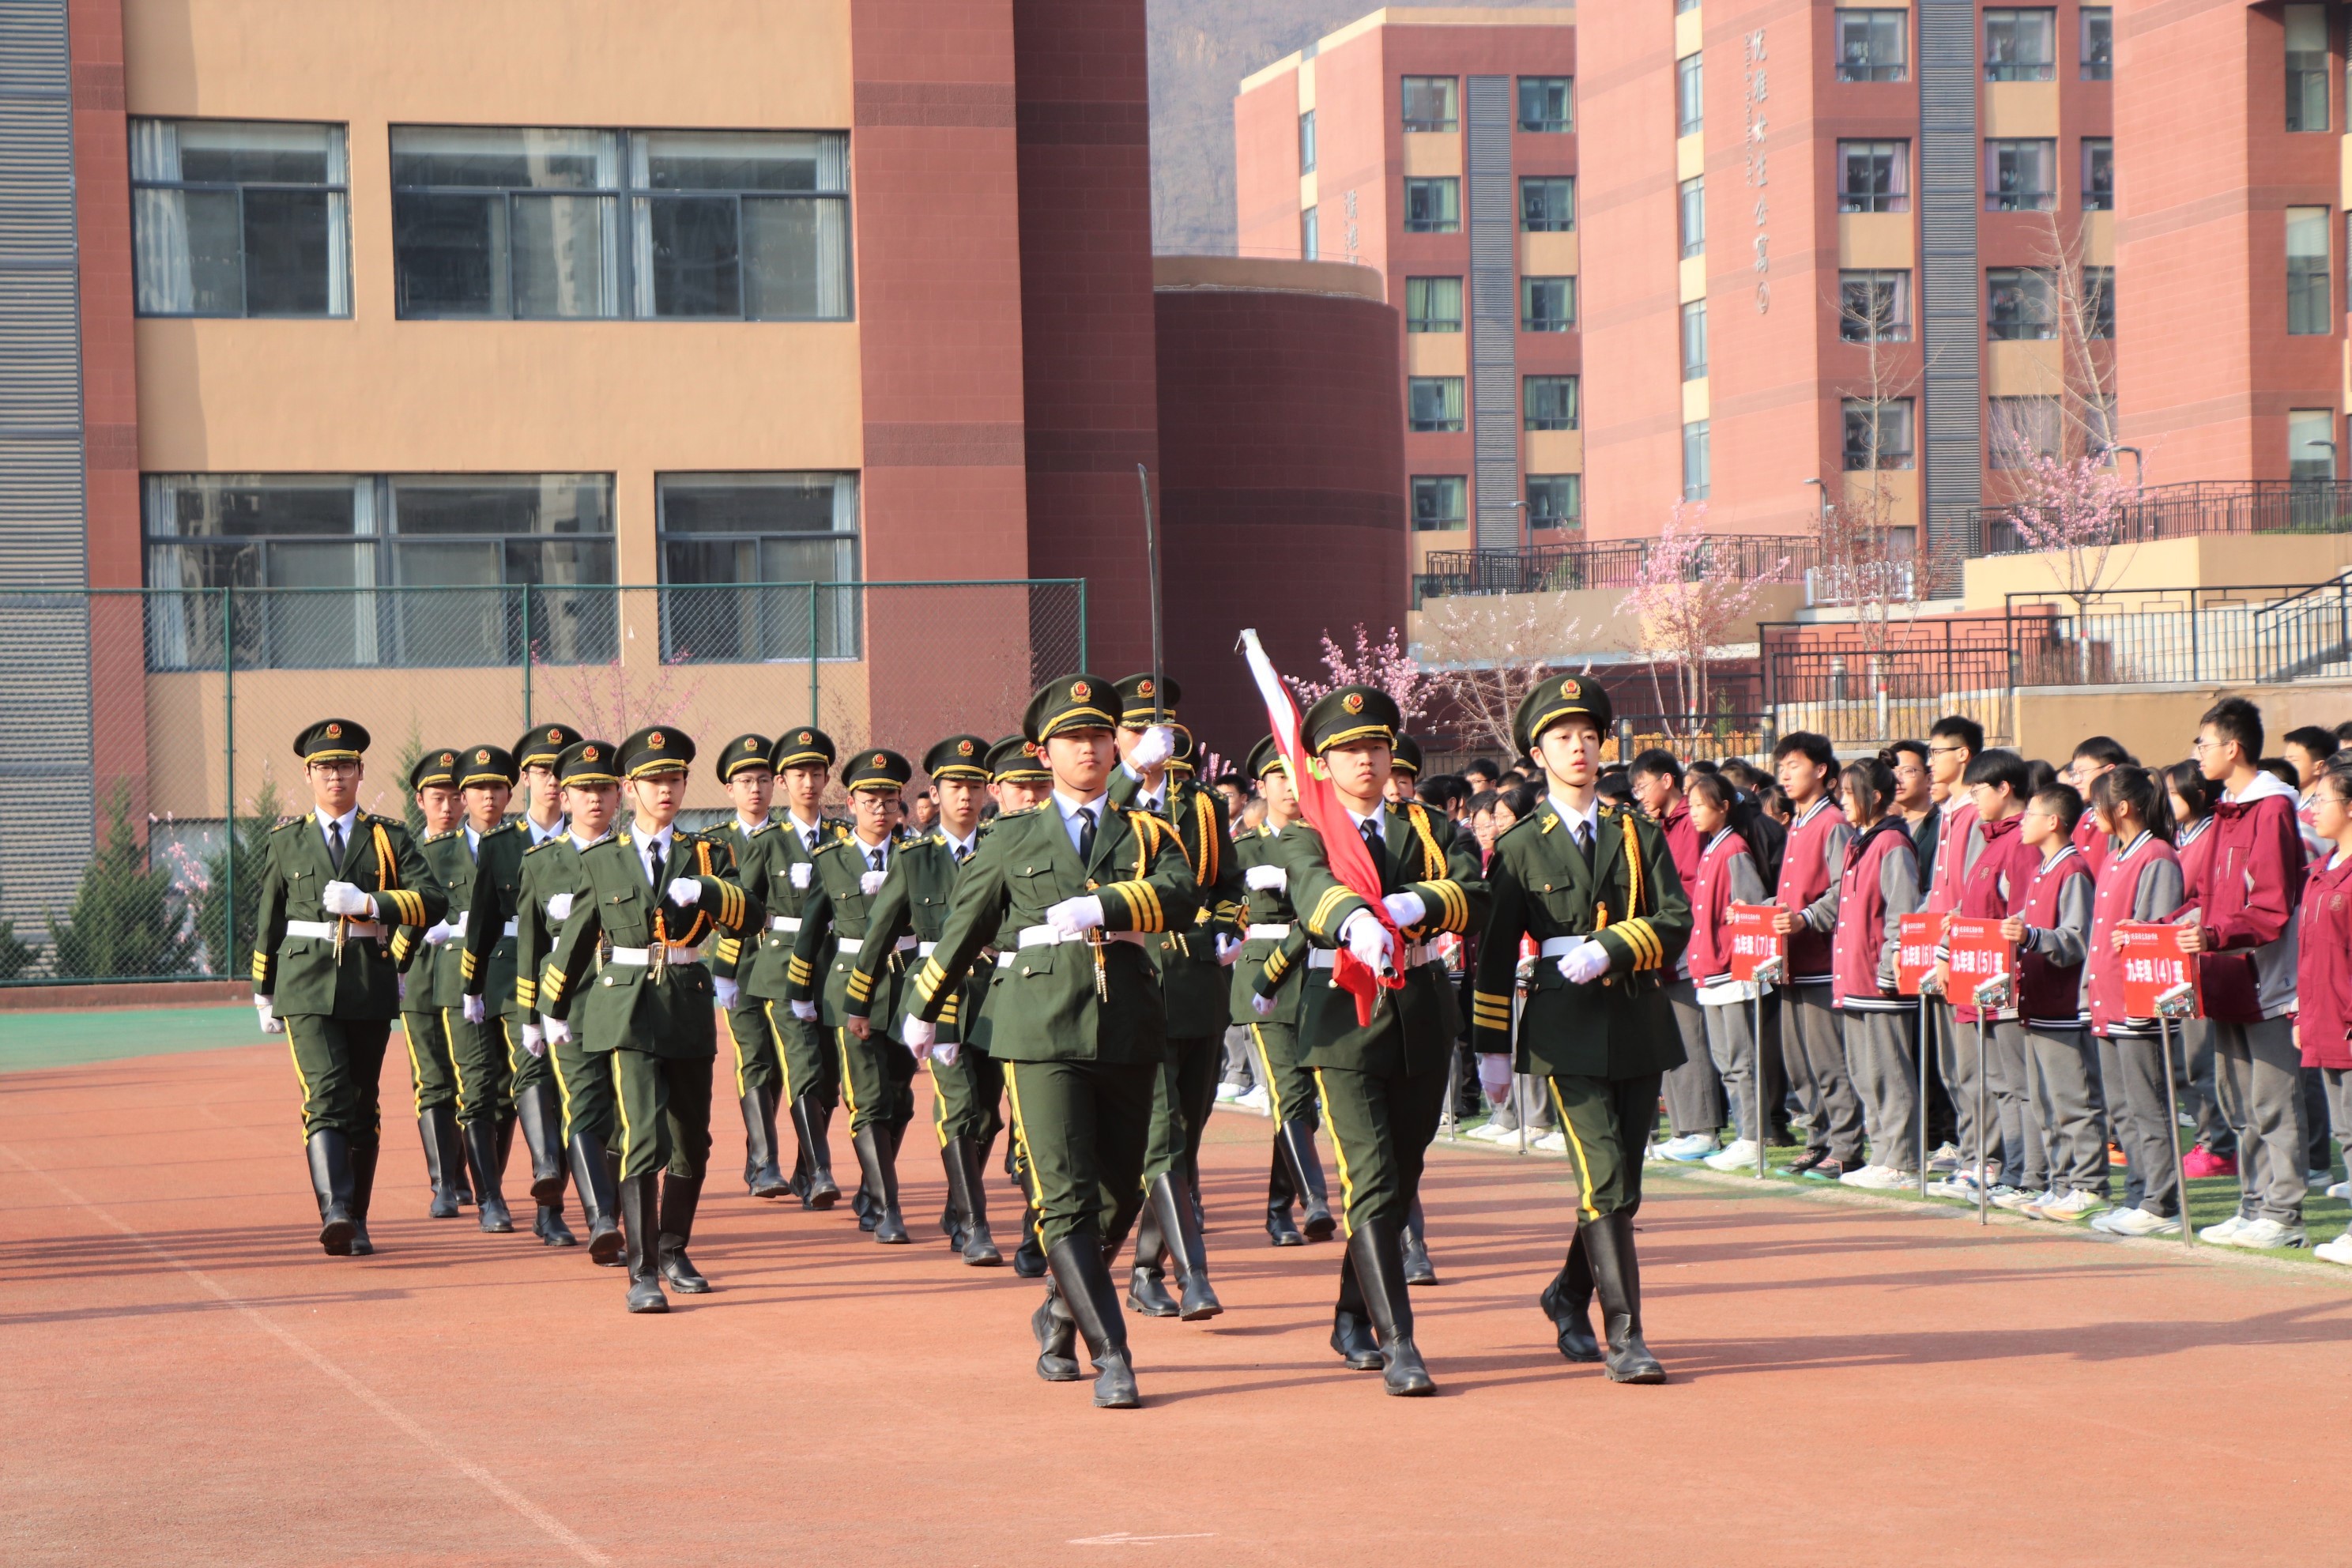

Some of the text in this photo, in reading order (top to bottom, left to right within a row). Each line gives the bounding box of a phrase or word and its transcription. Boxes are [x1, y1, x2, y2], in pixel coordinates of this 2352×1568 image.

[1951, 949, 2003, 974] 九年级(5)班
[2125, 957, 2184, 985] 九年级(4)班
